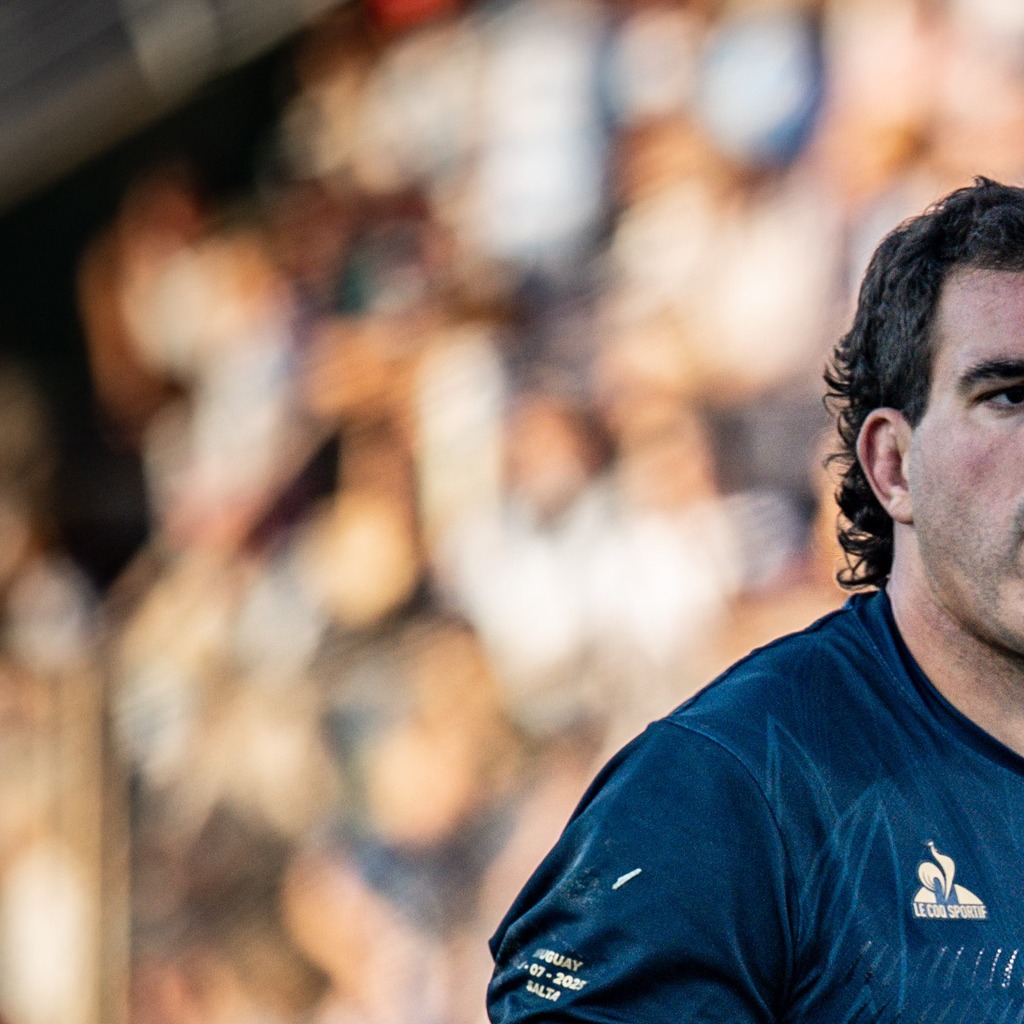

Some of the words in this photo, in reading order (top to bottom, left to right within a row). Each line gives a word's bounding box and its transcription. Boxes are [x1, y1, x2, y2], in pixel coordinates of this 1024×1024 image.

[913, 903, 926, 917] LE
[529, 964, 545, 977] 07
[526, 979, 561, 1002] SALTA
